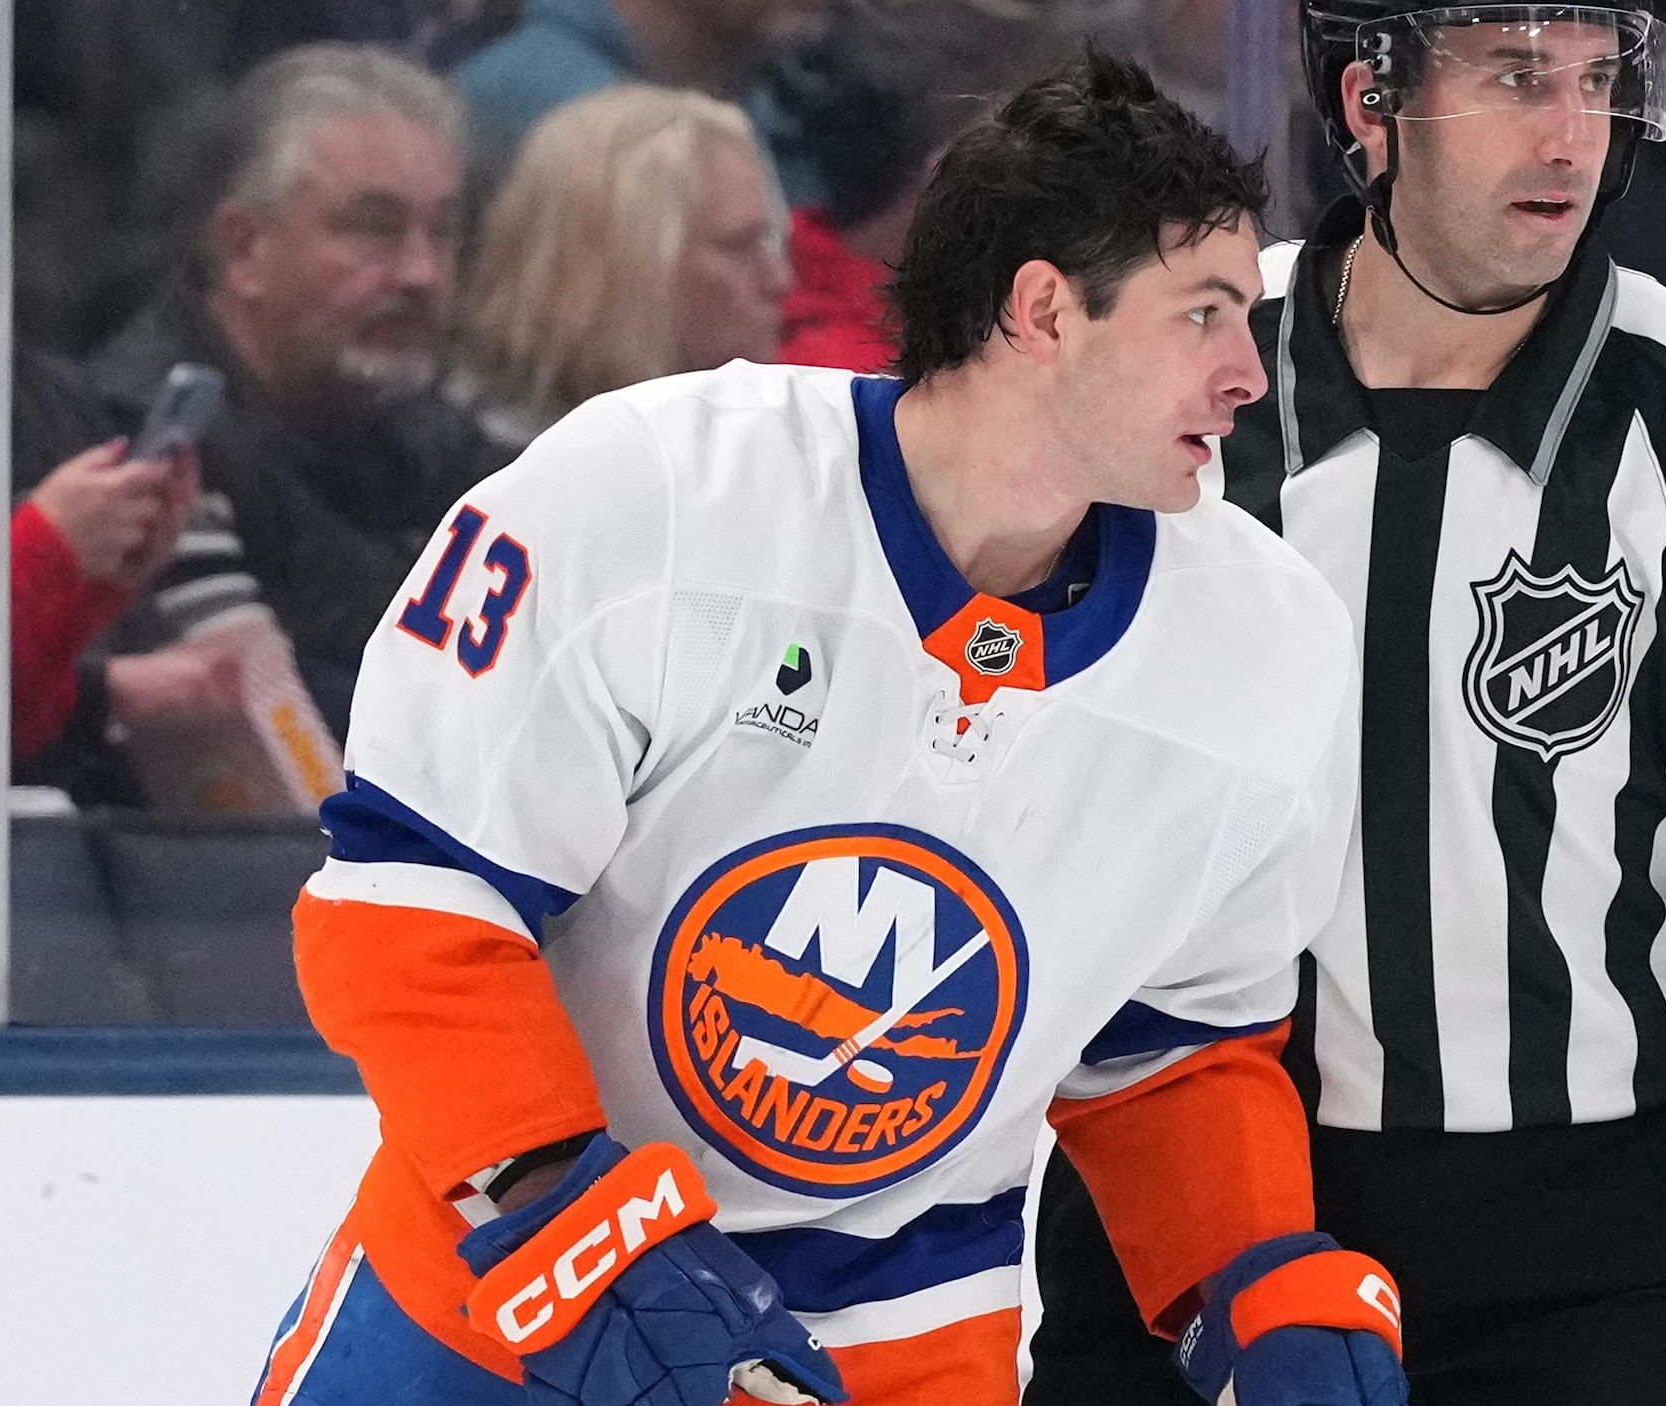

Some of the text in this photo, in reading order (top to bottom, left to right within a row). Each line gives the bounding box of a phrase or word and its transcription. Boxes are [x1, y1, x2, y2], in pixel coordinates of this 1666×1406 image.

[395, 503, 531, 680] 13
[974, 640, 1011, 658] NHL
[1507, 618, 1611, 712] NHL
[689, 983, 947, 1154] ISLANDERS
[495, 1168, 686, 1344] CCM
